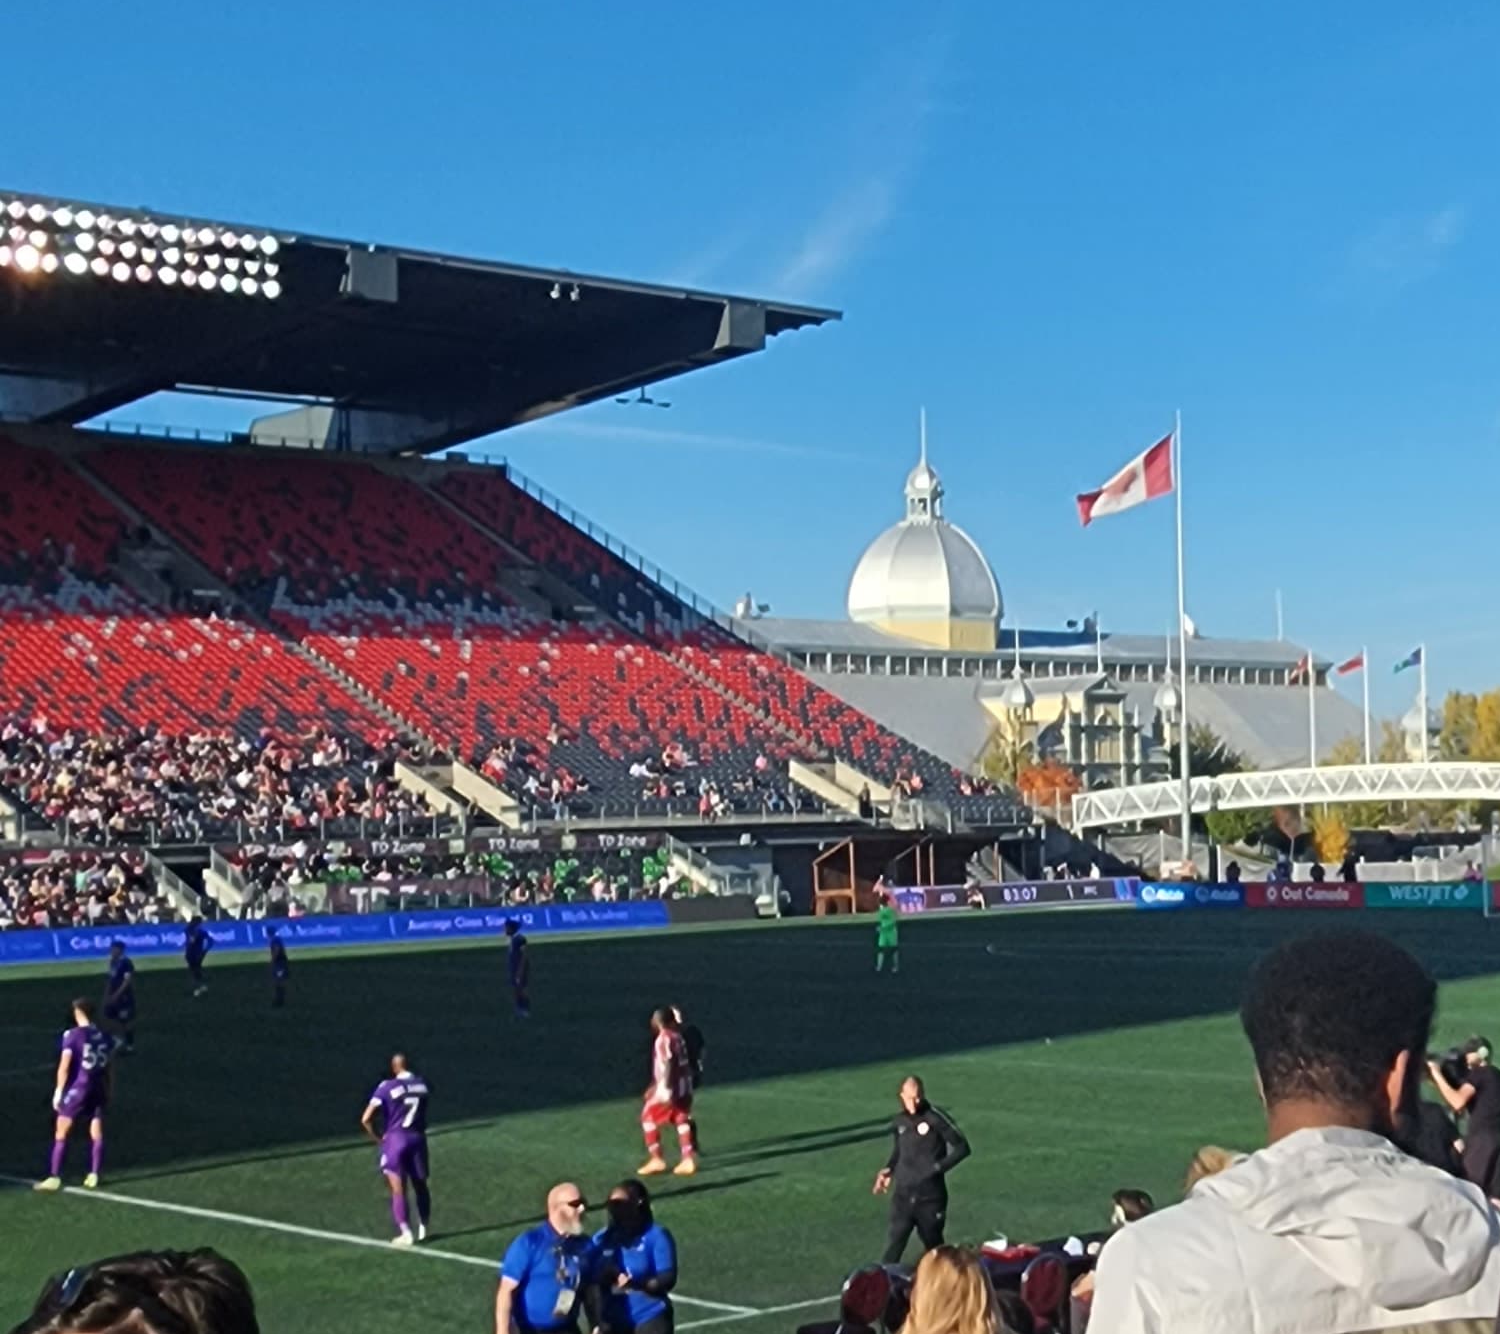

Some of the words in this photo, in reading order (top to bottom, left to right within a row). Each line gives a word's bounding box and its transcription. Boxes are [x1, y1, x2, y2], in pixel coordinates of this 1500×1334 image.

[488, 838, 506, 849] TD
[509, 838, 540, 850] Zone
[598, 835, 615, 847] TD
[617, 834, 647, 846] Zone
[371, 842, 389, 854] TD
[392, 842, 426, 854] Zone
[1388, 884, 1452, 904] WESTJET
[161, 933, 187, 947] Hig
[402, 1097, 420, 1127] 7
